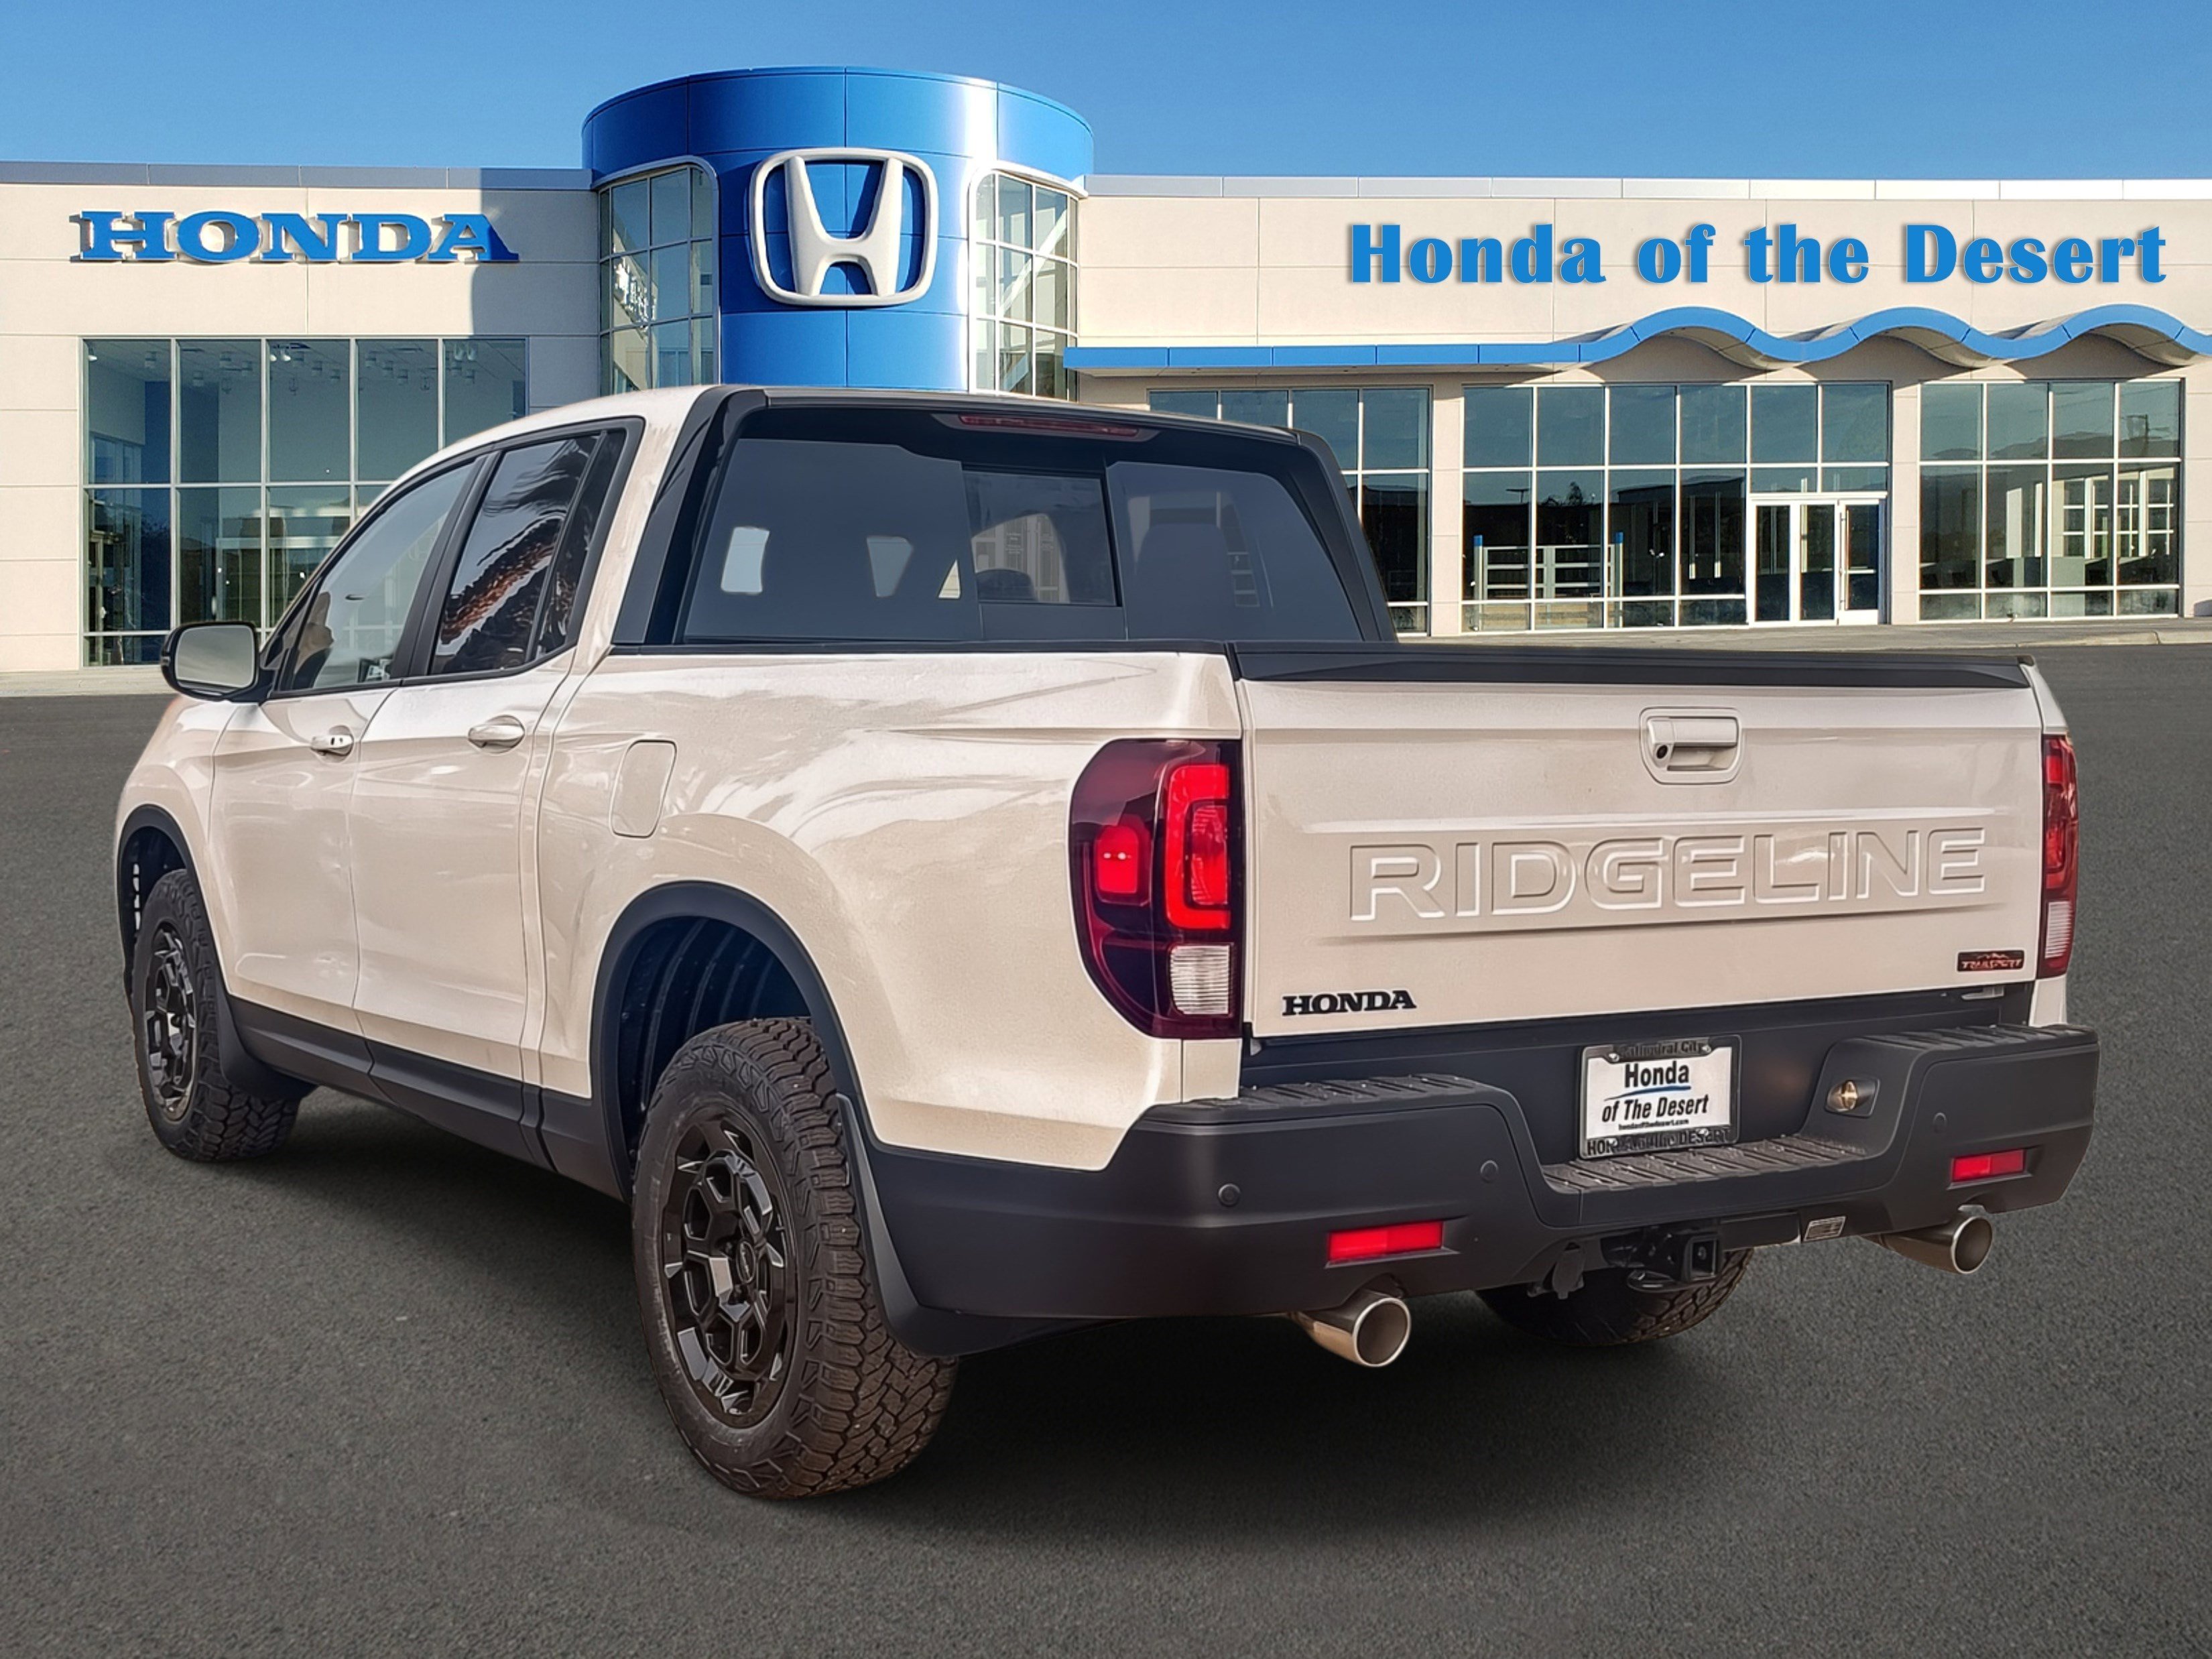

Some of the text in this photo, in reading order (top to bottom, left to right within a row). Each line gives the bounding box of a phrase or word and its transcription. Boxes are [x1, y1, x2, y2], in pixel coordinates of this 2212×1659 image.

[80, 210, 520, 262] HONDA
[1352, 223, 2166, 284] Honda of the Desert
[1349, 827, 1986, 921] RIDGELINE
[1282, 989, 1417, 1016] HONDA
[1624, 1060, 1690, 1088] Honda
[1601, 1093, 1709, 1122] of The Desert
